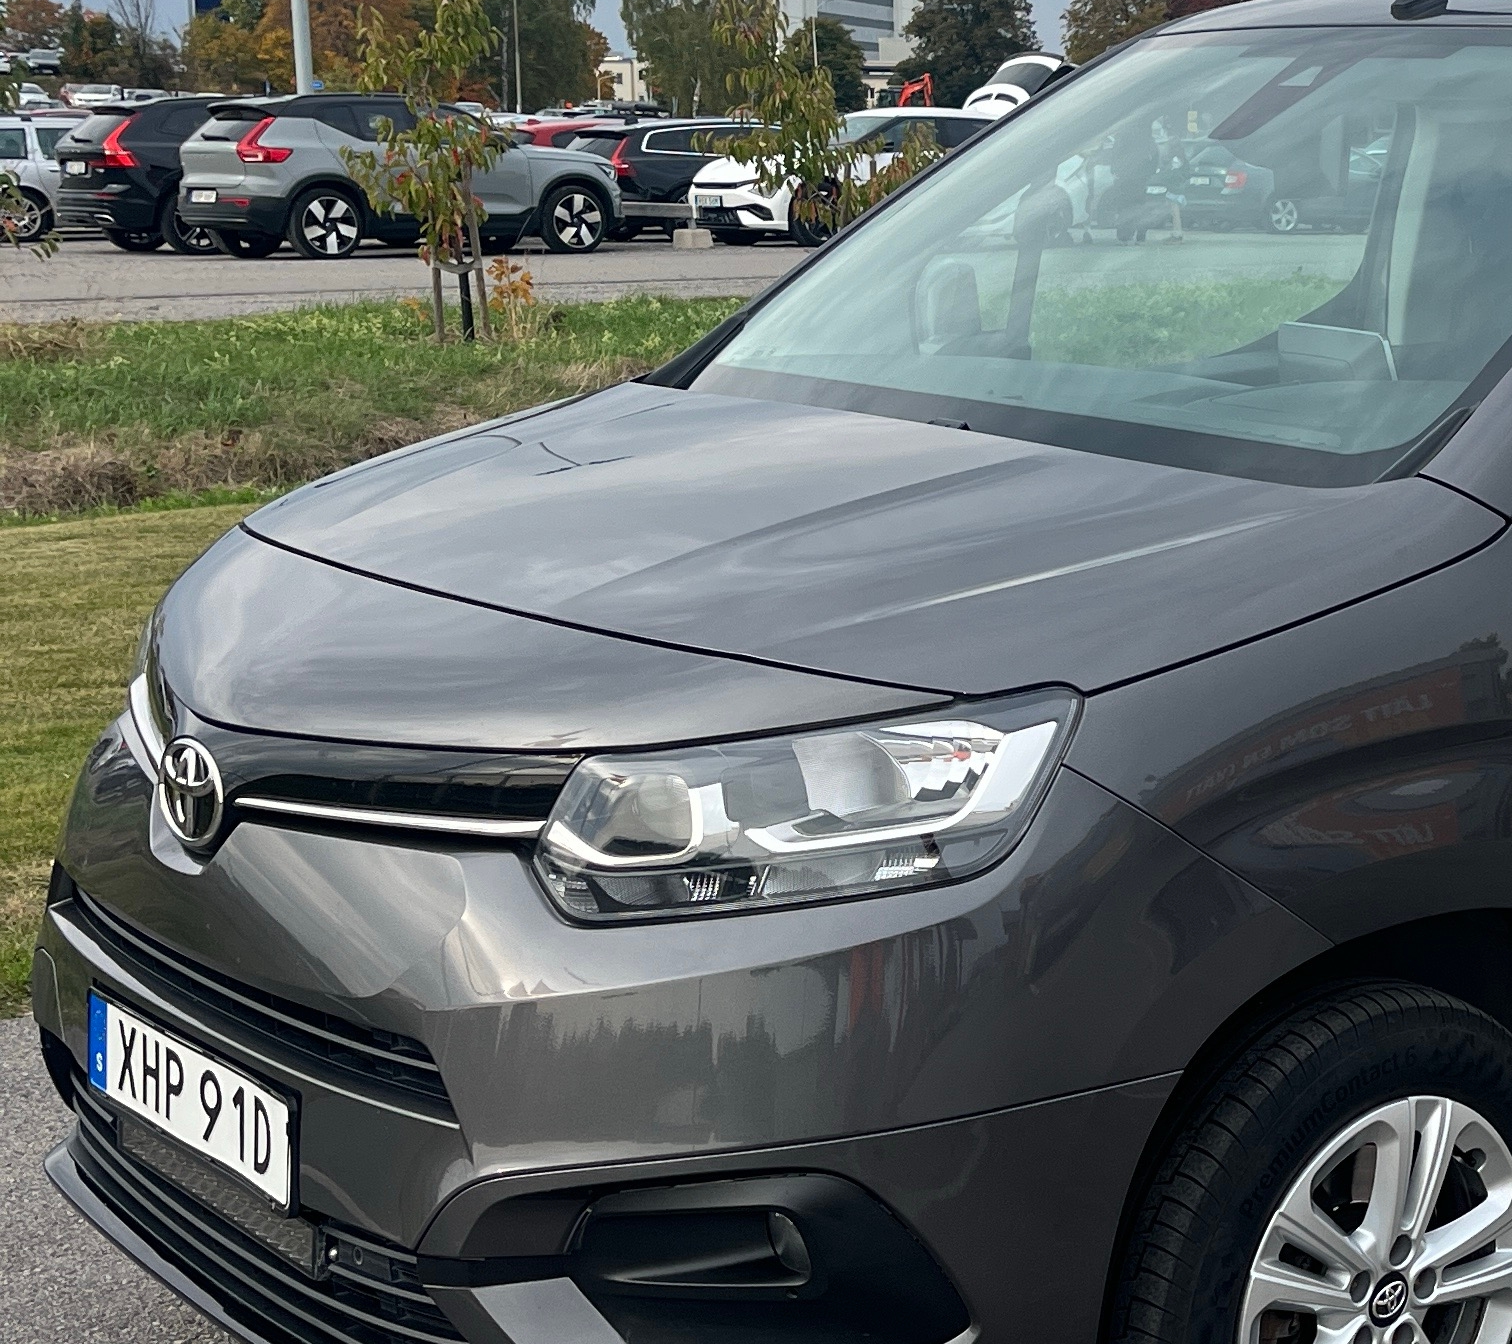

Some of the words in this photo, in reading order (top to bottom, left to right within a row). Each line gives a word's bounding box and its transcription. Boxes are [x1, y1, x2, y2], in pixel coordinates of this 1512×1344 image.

[95, 1052, 104, 1072] S
[118, 1018, 184, 1121] XHP
[200, 1069, 271, 1175] 91D
[1238, 1054, 1399, 1218] PremiumContact
[1404, 1044, 1417, 1063] 6
